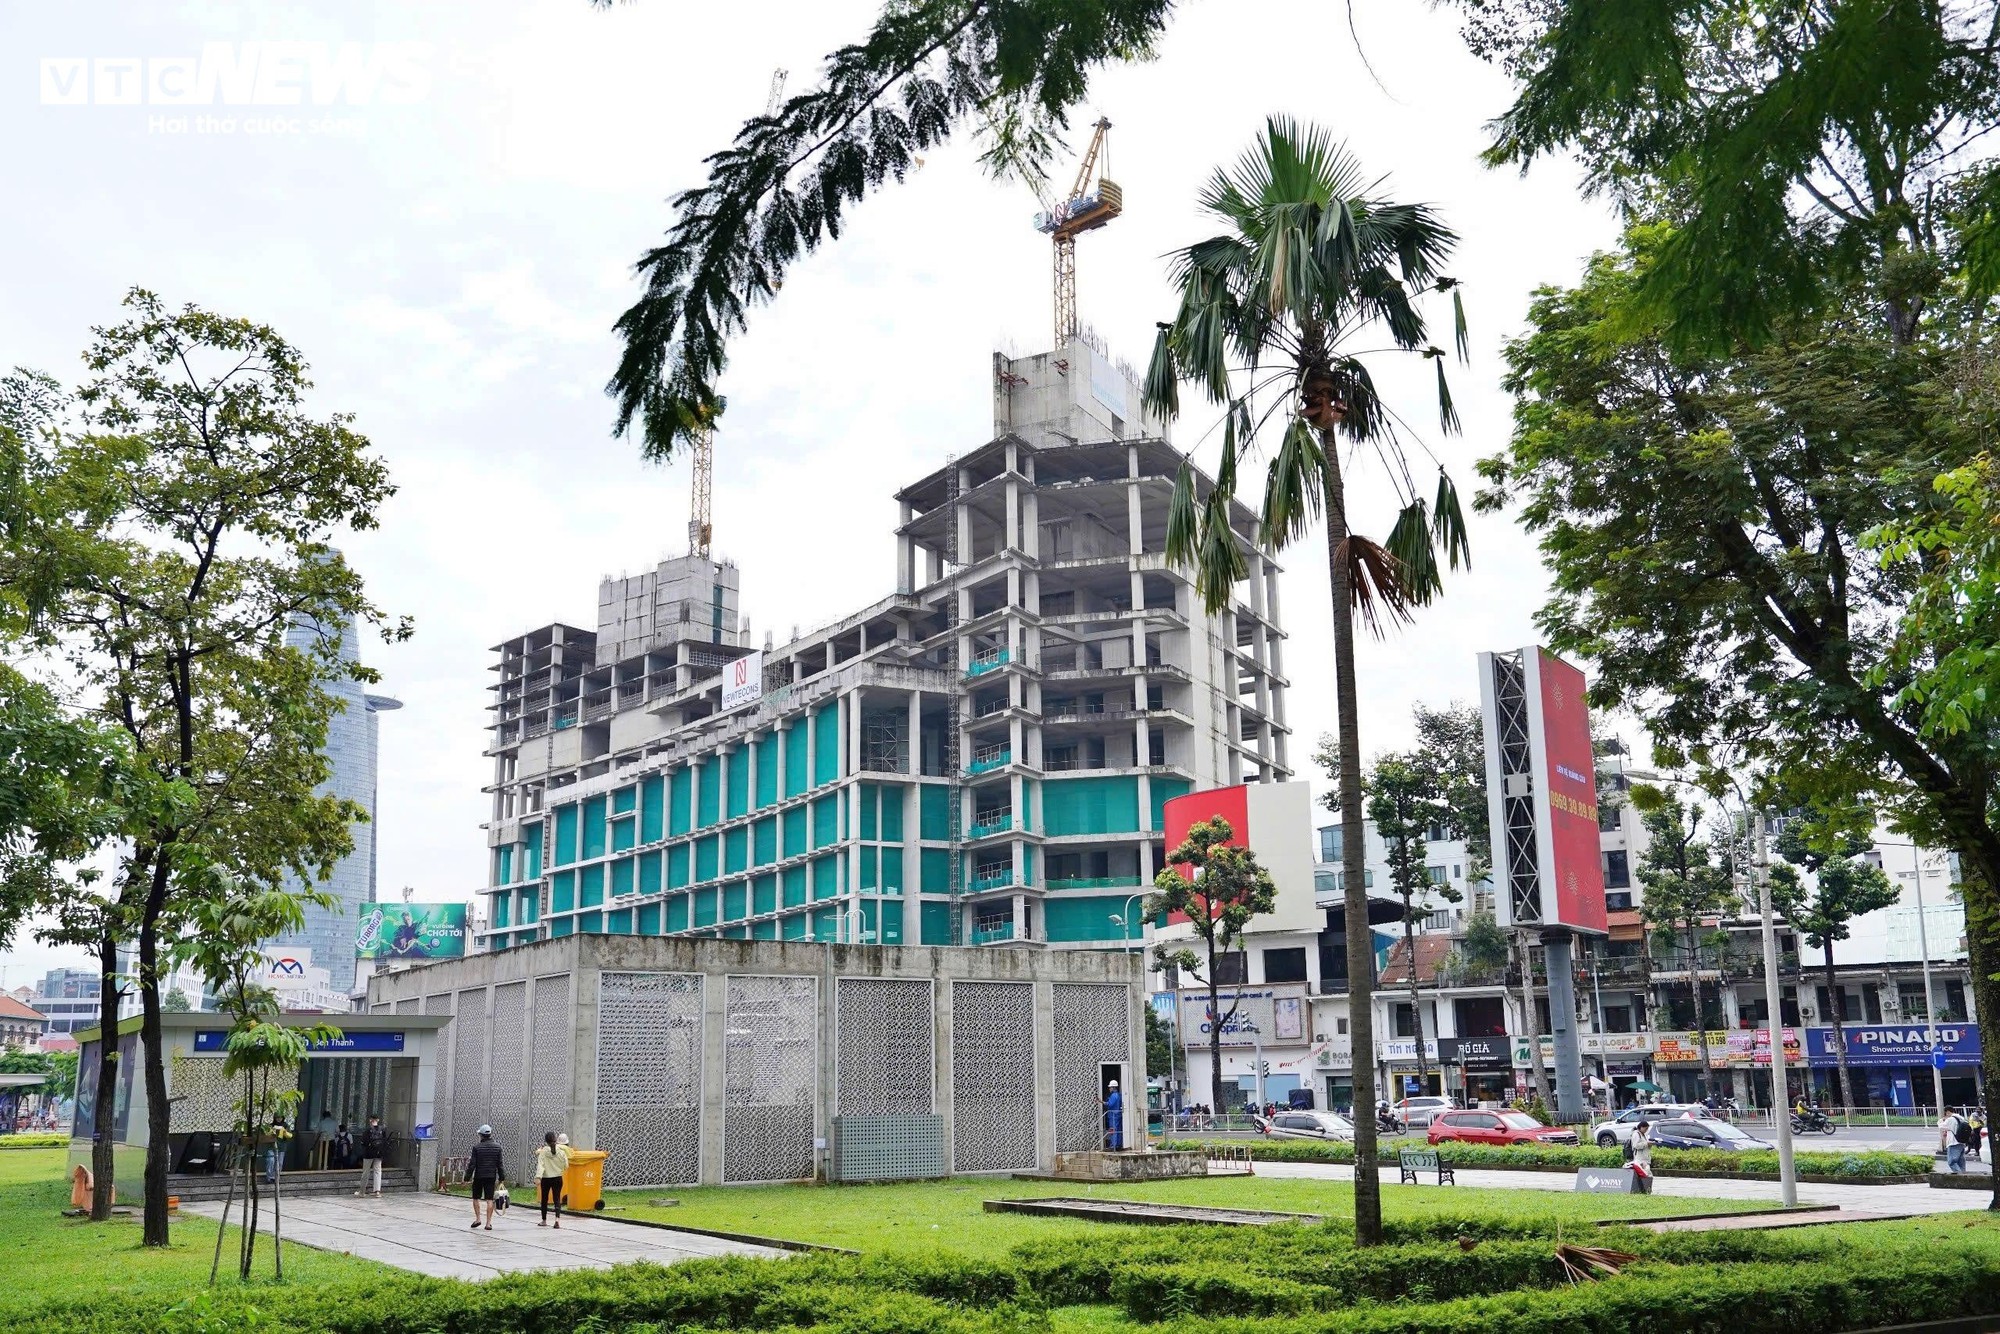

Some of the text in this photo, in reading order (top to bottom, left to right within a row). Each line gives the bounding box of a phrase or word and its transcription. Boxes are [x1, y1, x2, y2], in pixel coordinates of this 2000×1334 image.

[722, 683, 759, 704] NEWTECONS
[1871, 1045, 1914, 1053] Showroom
[1600, 1178, 1624, 1186] VNPAY
